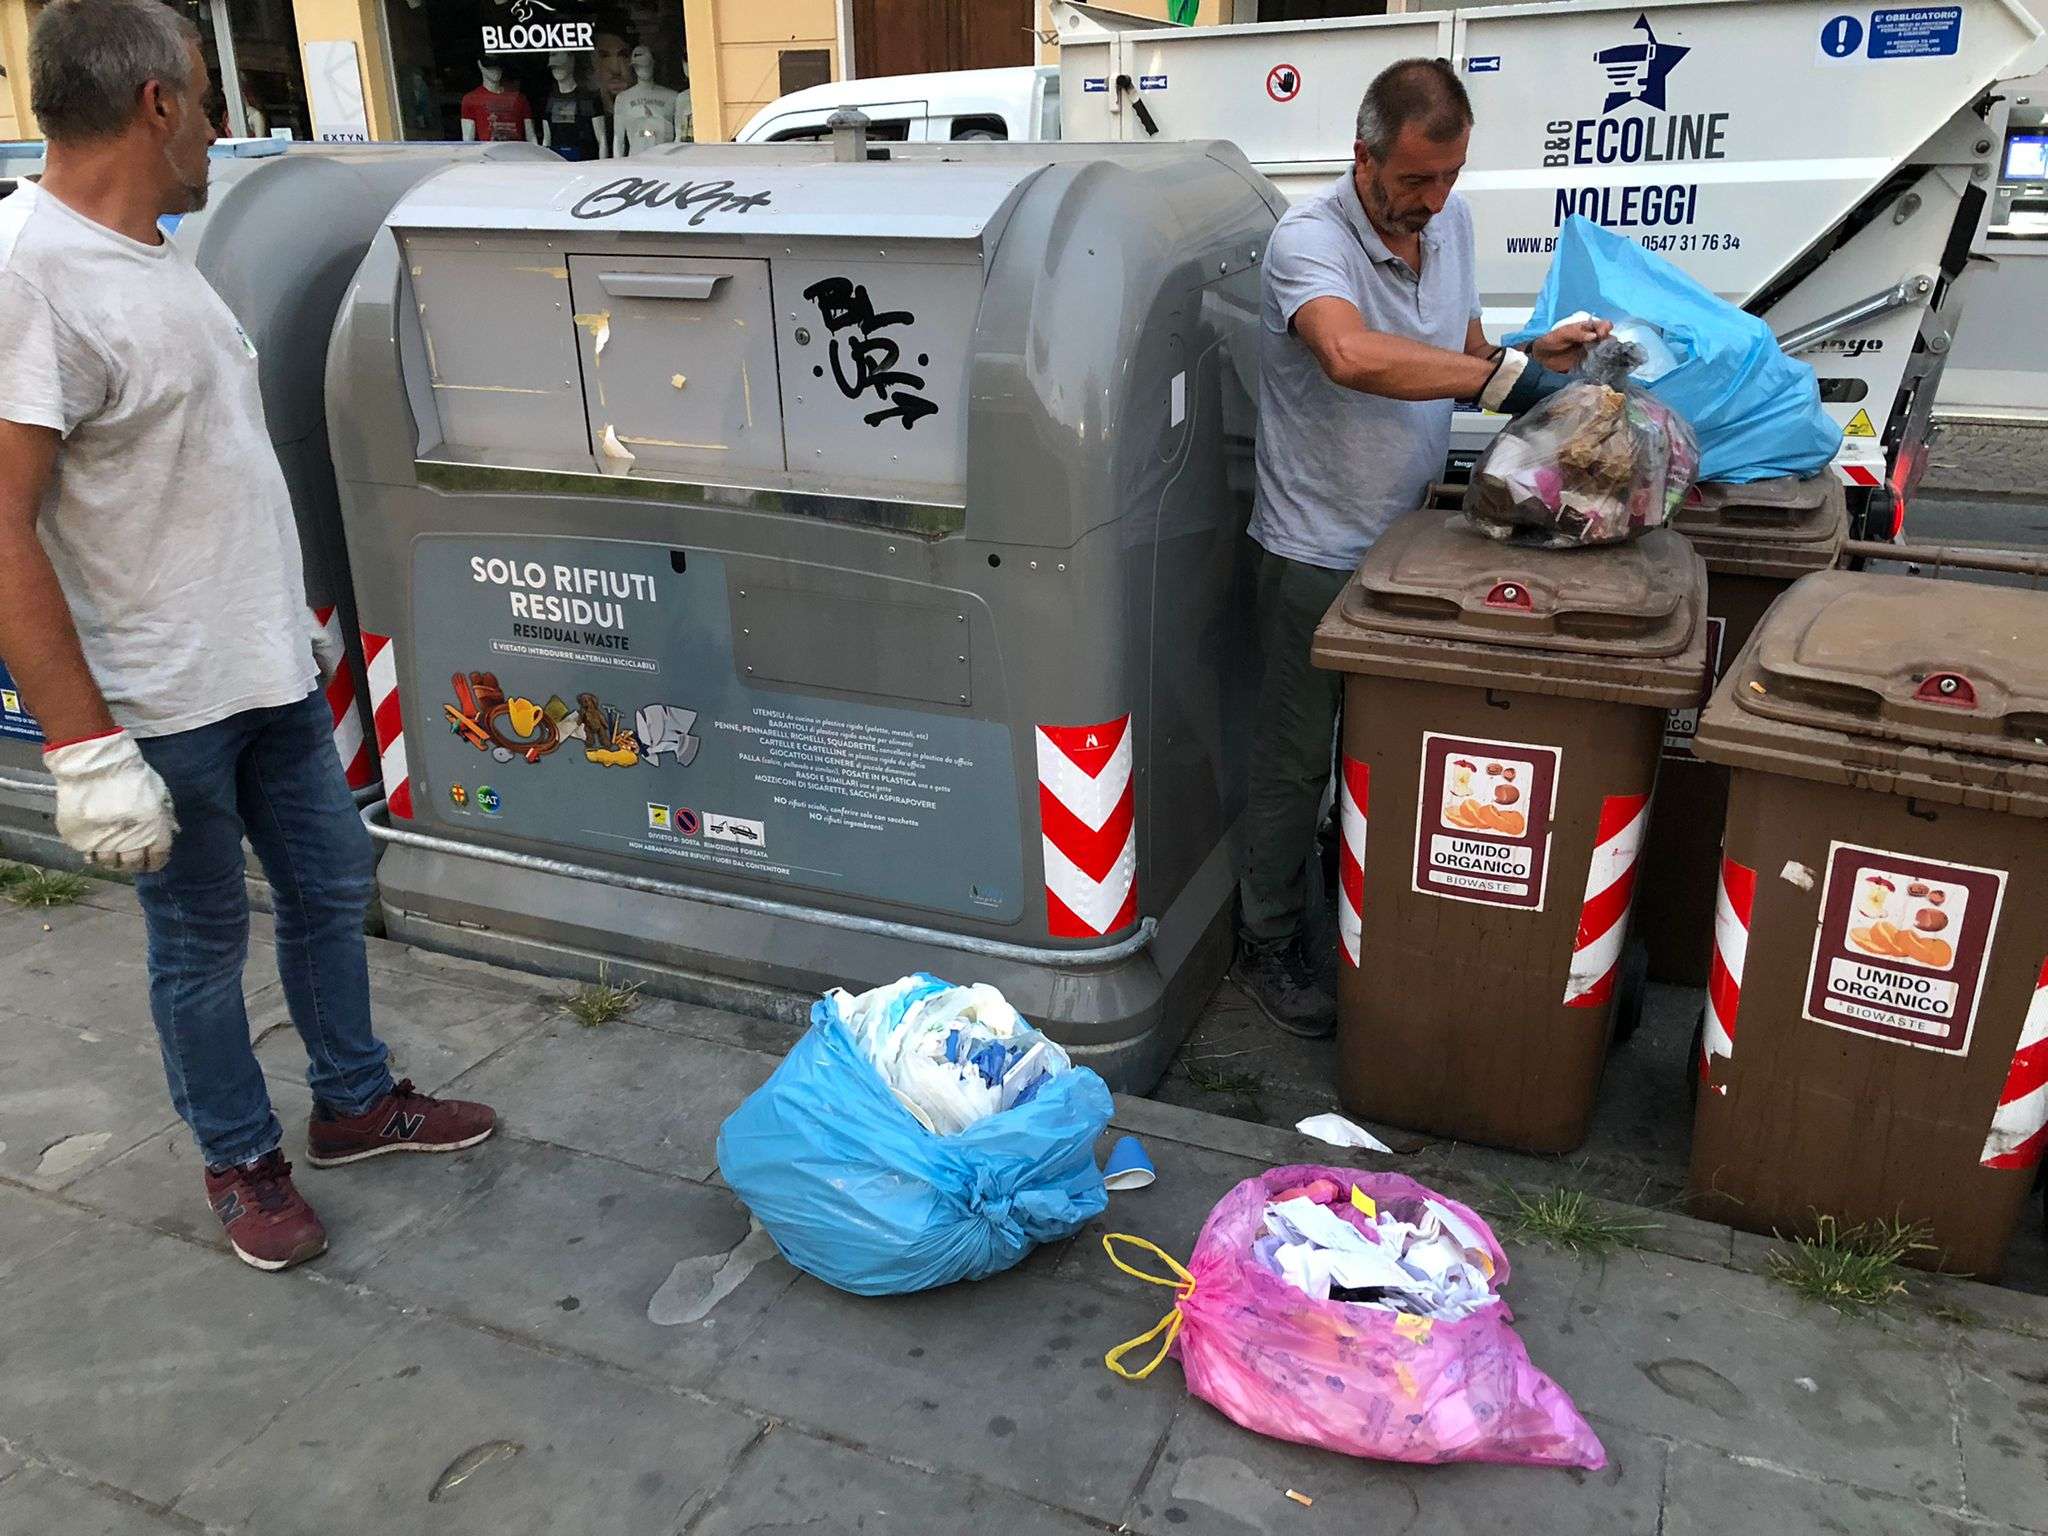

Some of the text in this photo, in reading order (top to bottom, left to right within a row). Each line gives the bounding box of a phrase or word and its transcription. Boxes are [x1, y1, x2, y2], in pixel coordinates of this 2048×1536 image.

[1885, 11, 1958, 22] OBBLIGATORIO
[482, 22, 593, 49] BLOOKER
[1543, 120, 1573, 167] B&G
[1573, 113, 1730, 165] ECOLINE
[1554, 184, 1698, 228] NOLEGGI
[1642, 235, 1676, 251] 0547
[1680, 235, 1696, 251] 31
[1702, 234, 1719, 250] 76
[1723, 233, 1740, 250] 34
[470, 556, 657, 602] SOLO RIFIUTI
[509, 591, 625, 630] RESIDUI
[513, 623, 630, 651] RESIDUAL WASTE
[499, 643, 527, 654] VIETATO
[528, 647, 574, 660] INTRODURRE
[575, 653, 612, 665] MATERIALI
[613, 658, 656, 671] RICICLABILI
[714, 721, 742, 732] PENNE,
[768, 720, 808, 732] BARATTOLI
[759, 737, 795, 749] CARTELLE
[802, 744, 847, 757] CARTELLINE
[769, 748, 813, 761] GIOCATTOLI
[815, 755, 823, 763] IN
[824, 756, 855, 768] GENERE
[754, 774, 796, 787] MOZZICONI
[798, 780, 806, 788] DI
[849, 789, 878, 800] SACCHI
[796, 771, 818, 781] RASOI
[826, 775, 859, 788] SIMILARI
[841, 768, 870, 780] POSATE
[871, 773, 880, 781] IN
[881, 775, 917, 787] PLASTICA
[477, 793, 498, 805] SAT
[774, 796, 787, 805] NO
[629, 842, 643, 850] NON
[690, 851, 711, 861] RIFIUTI
[733, 859, 745, 867] DAL
[745, 861, 790, 876] CONTENITORE
[681, 837, 700, 847] SOSTA
[740, 847, 768, 859] FORZATA
[1452, 840, 1511, 859] UMIDO
[1434, 852, 1526, 876] ORGANICO
[1446, 875, 1510, 892] BIOWASTE
[1856, 966, 1931, 993] UMIDO
[1833, 978, 1949, 1014] ORGANICO
[1846, 1004, 1927, 1031] BIOWASTE
[380, 1110, 425, 1141] N
[215, 1190, 247, 1227] N
